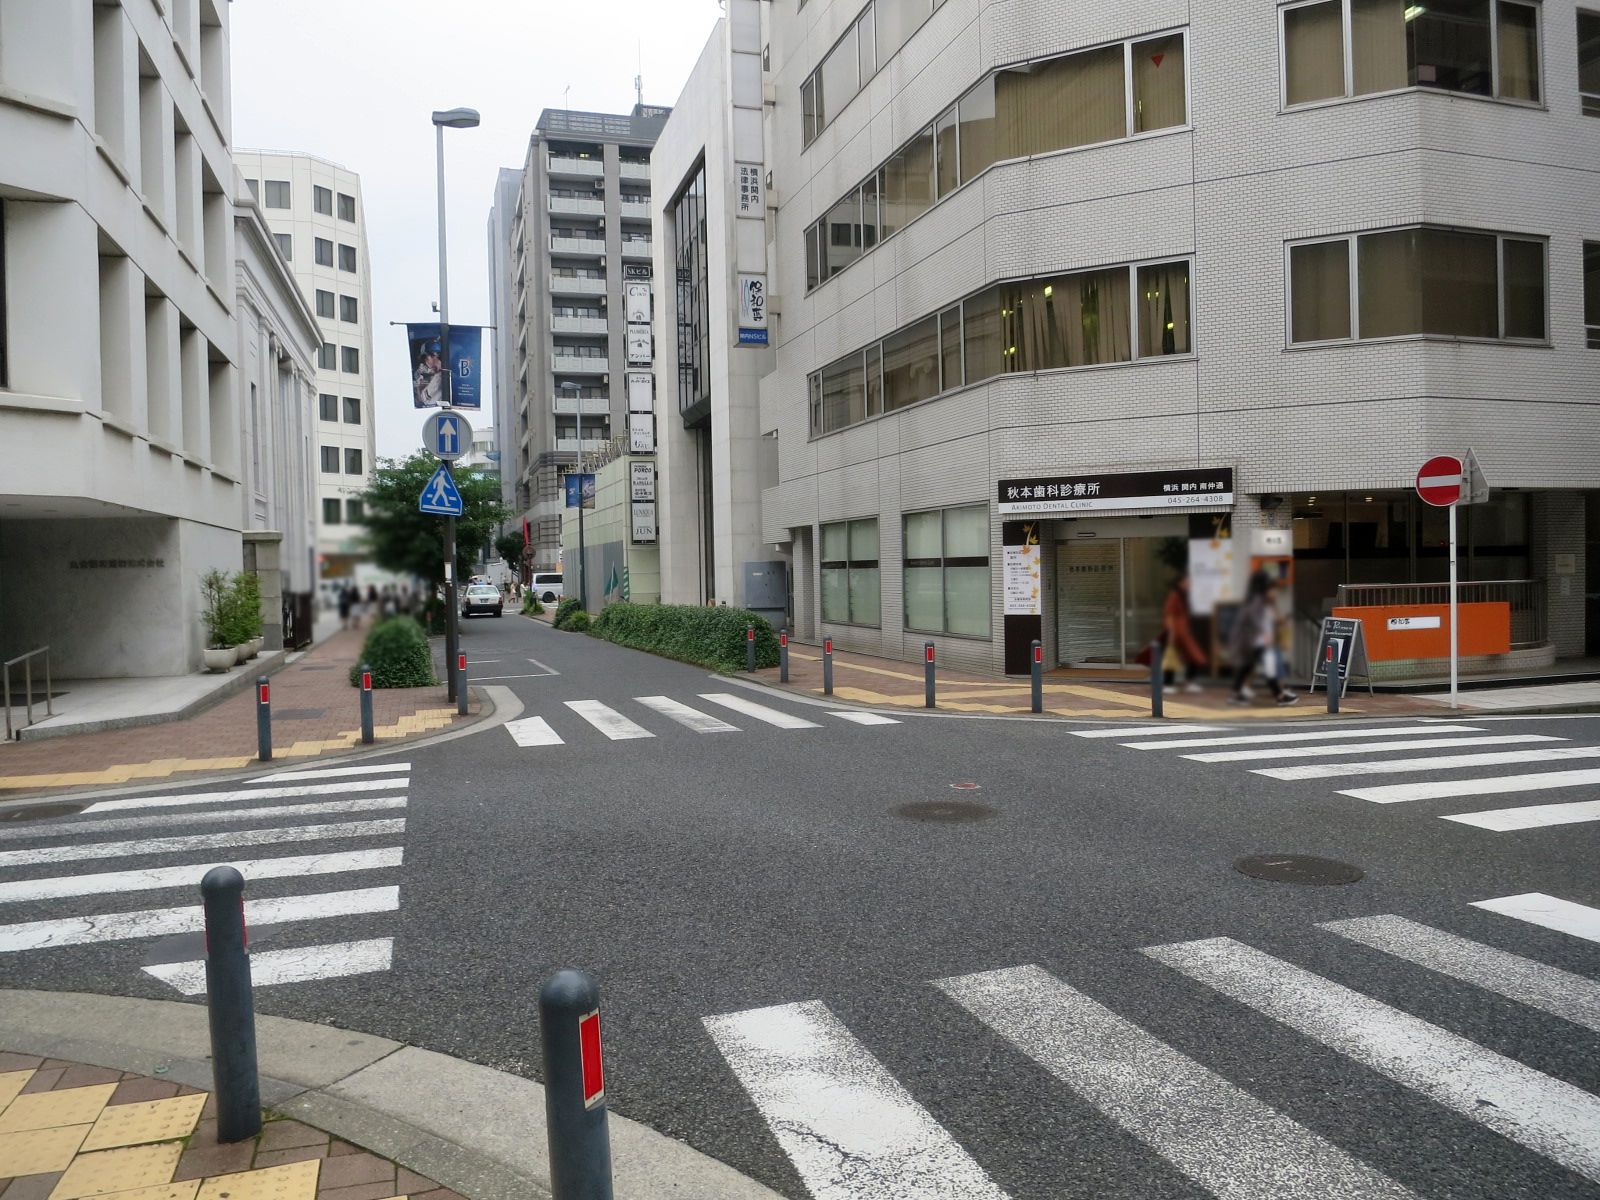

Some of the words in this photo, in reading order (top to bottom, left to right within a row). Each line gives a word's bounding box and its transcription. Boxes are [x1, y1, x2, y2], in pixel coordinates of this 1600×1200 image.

[740, 166, 750, 212] 法律事務所
[750, 168, 759, 204] 横浜関内
[1007, 482, 1101, 499] 秋本歯科診療所
[1163, 484, 1180, 492] 横浜
[1181, 483, 1197, 491] 関内
